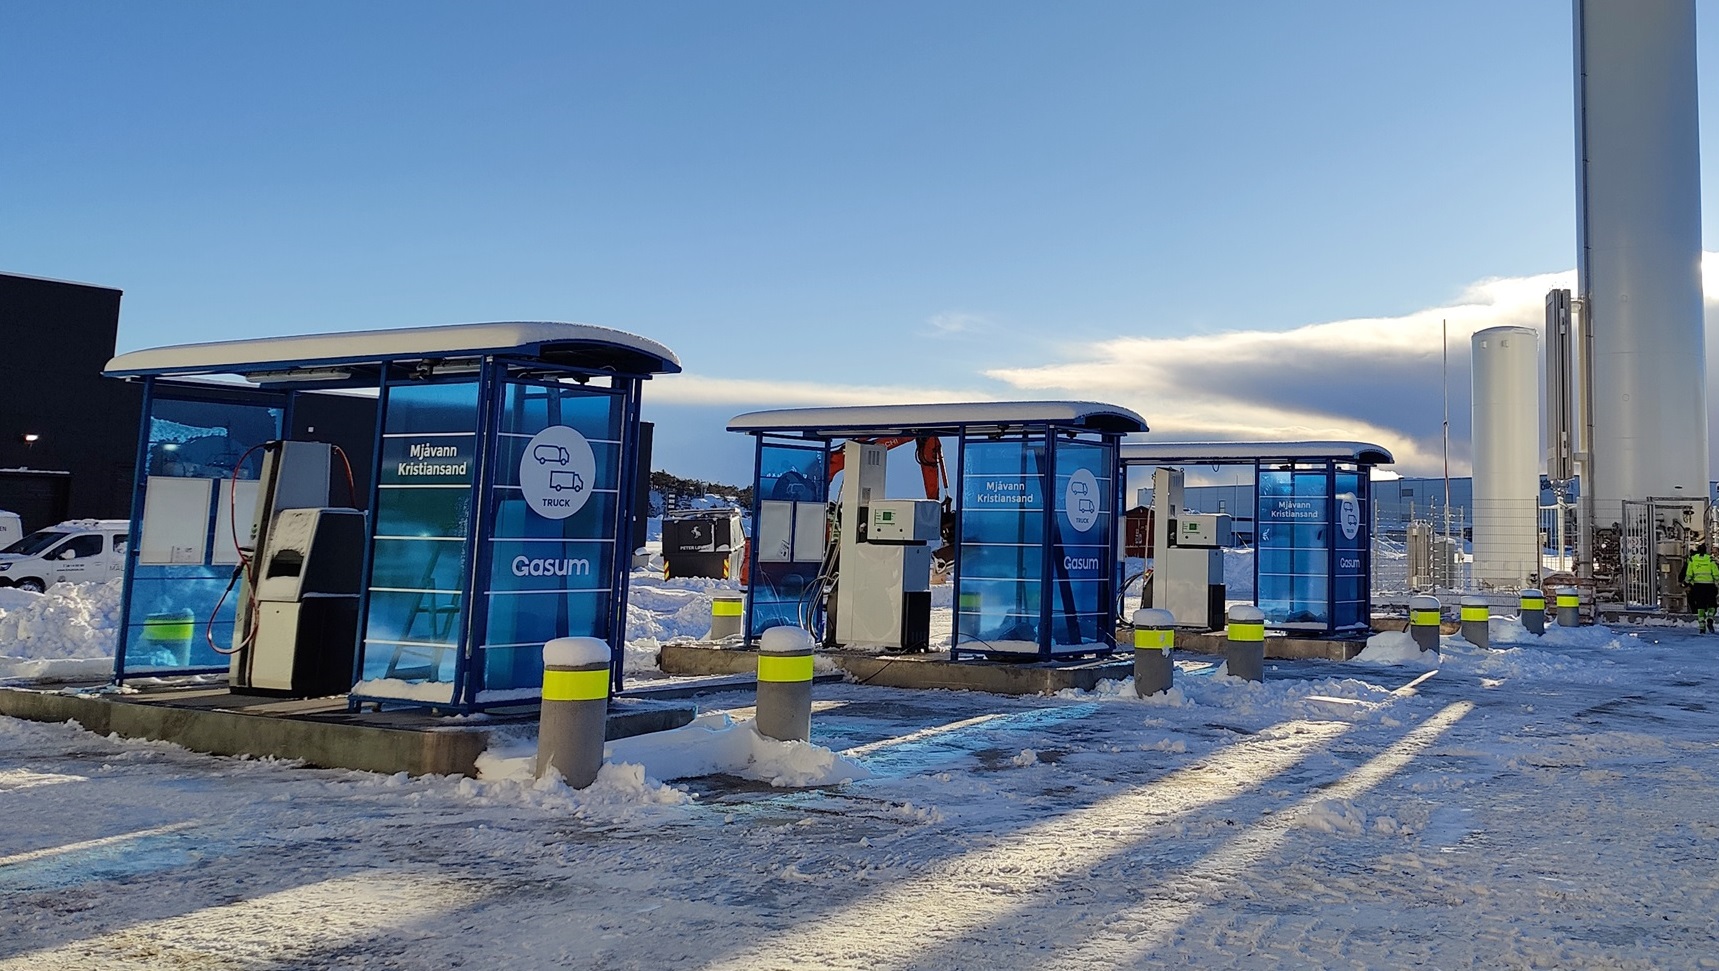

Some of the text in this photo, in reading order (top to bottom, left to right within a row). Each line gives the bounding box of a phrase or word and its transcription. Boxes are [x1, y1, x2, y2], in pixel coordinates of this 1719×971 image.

[410, 443, 457, 460] Mjåvann
[398, 462, 467, 476] Kristiansand
[986, 481, 1025, 493] Mjåvann
[542, 498, 571, 507] TRUCK
[977, 494, 1034, 503] Kristiansand
[1278, 501, 1311, 510] Mjåvann
[511, 555, 590, 577] Gasum
[1063, 556, 1099, 570] Gasum
